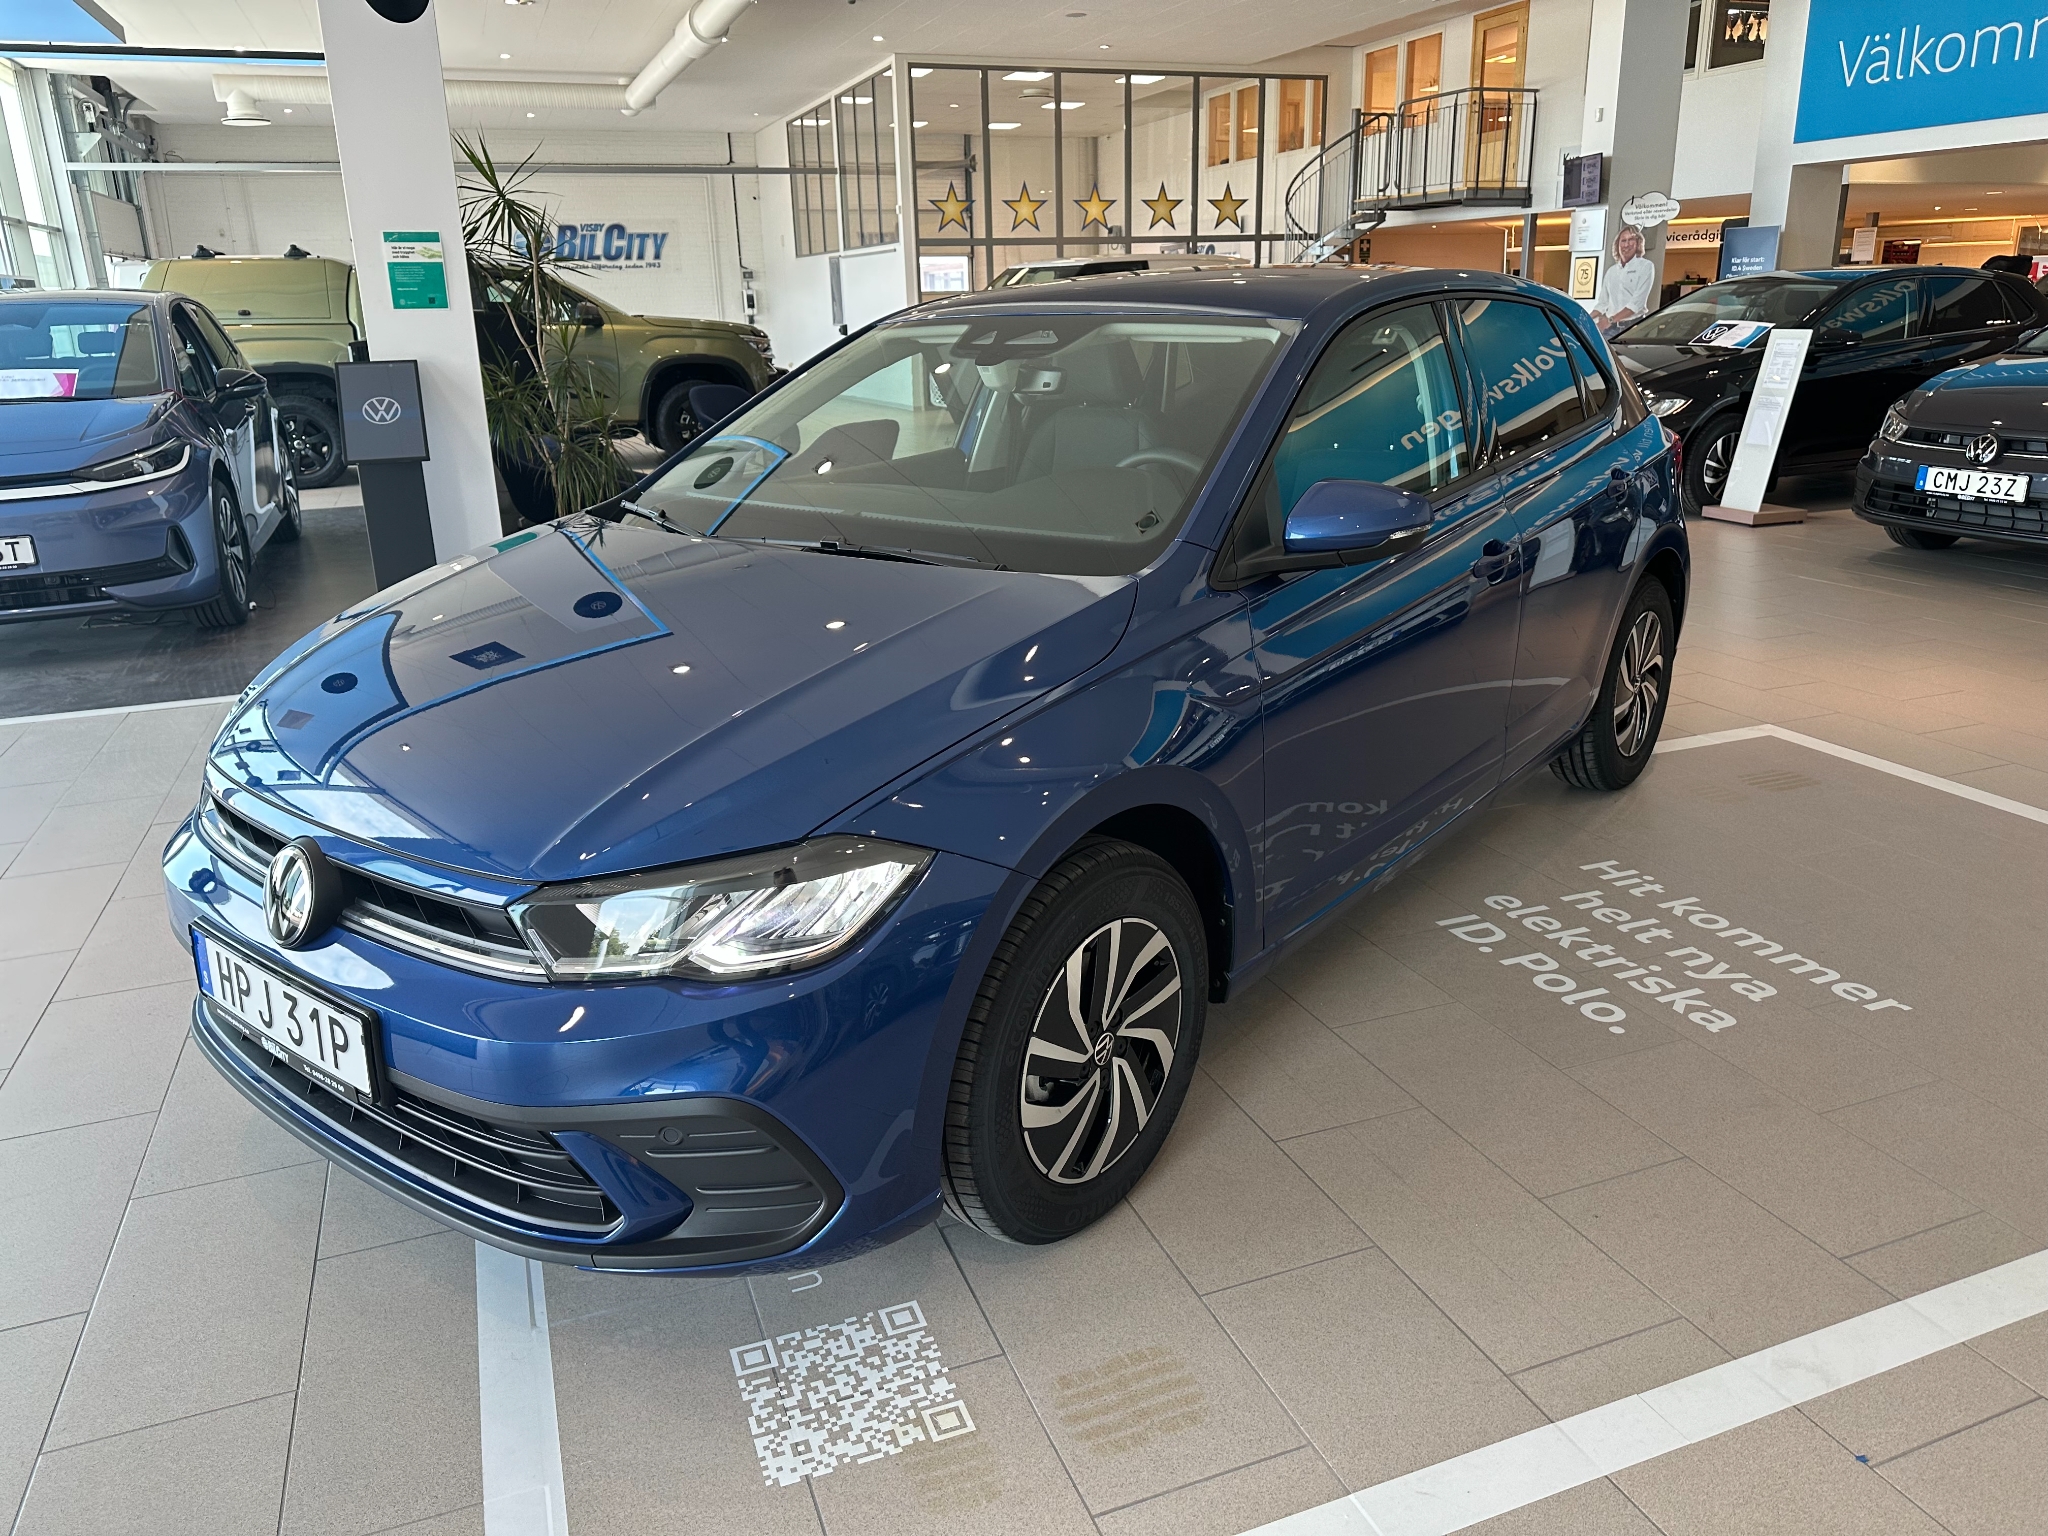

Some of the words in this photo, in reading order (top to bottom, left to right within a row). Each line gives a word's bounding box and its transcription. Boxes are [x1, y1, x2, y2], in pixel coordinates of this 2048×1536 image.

[580, 223, 605, 232] VISBY
[1580, 268, 1589, 279] 75
[1933, 471, 1970, 491] CMJ
[1977, 476, 2017, 497] 23Z
[1435, 913, 1507, 953] ID.
[1499, 951, 1627, 1035] Polo.
[1484, 895, 1738, 1033] elektriska
[1560, 890, 1674, 945] helt
[1665, 945, 1778, 1002] nya
[1579, 860, 1665, 897] Hit
[1657, 896, 1913, 1012] kommer
[215, 950, 273, 1029] HPJ
[282, 990, 349, 1070] 31P
